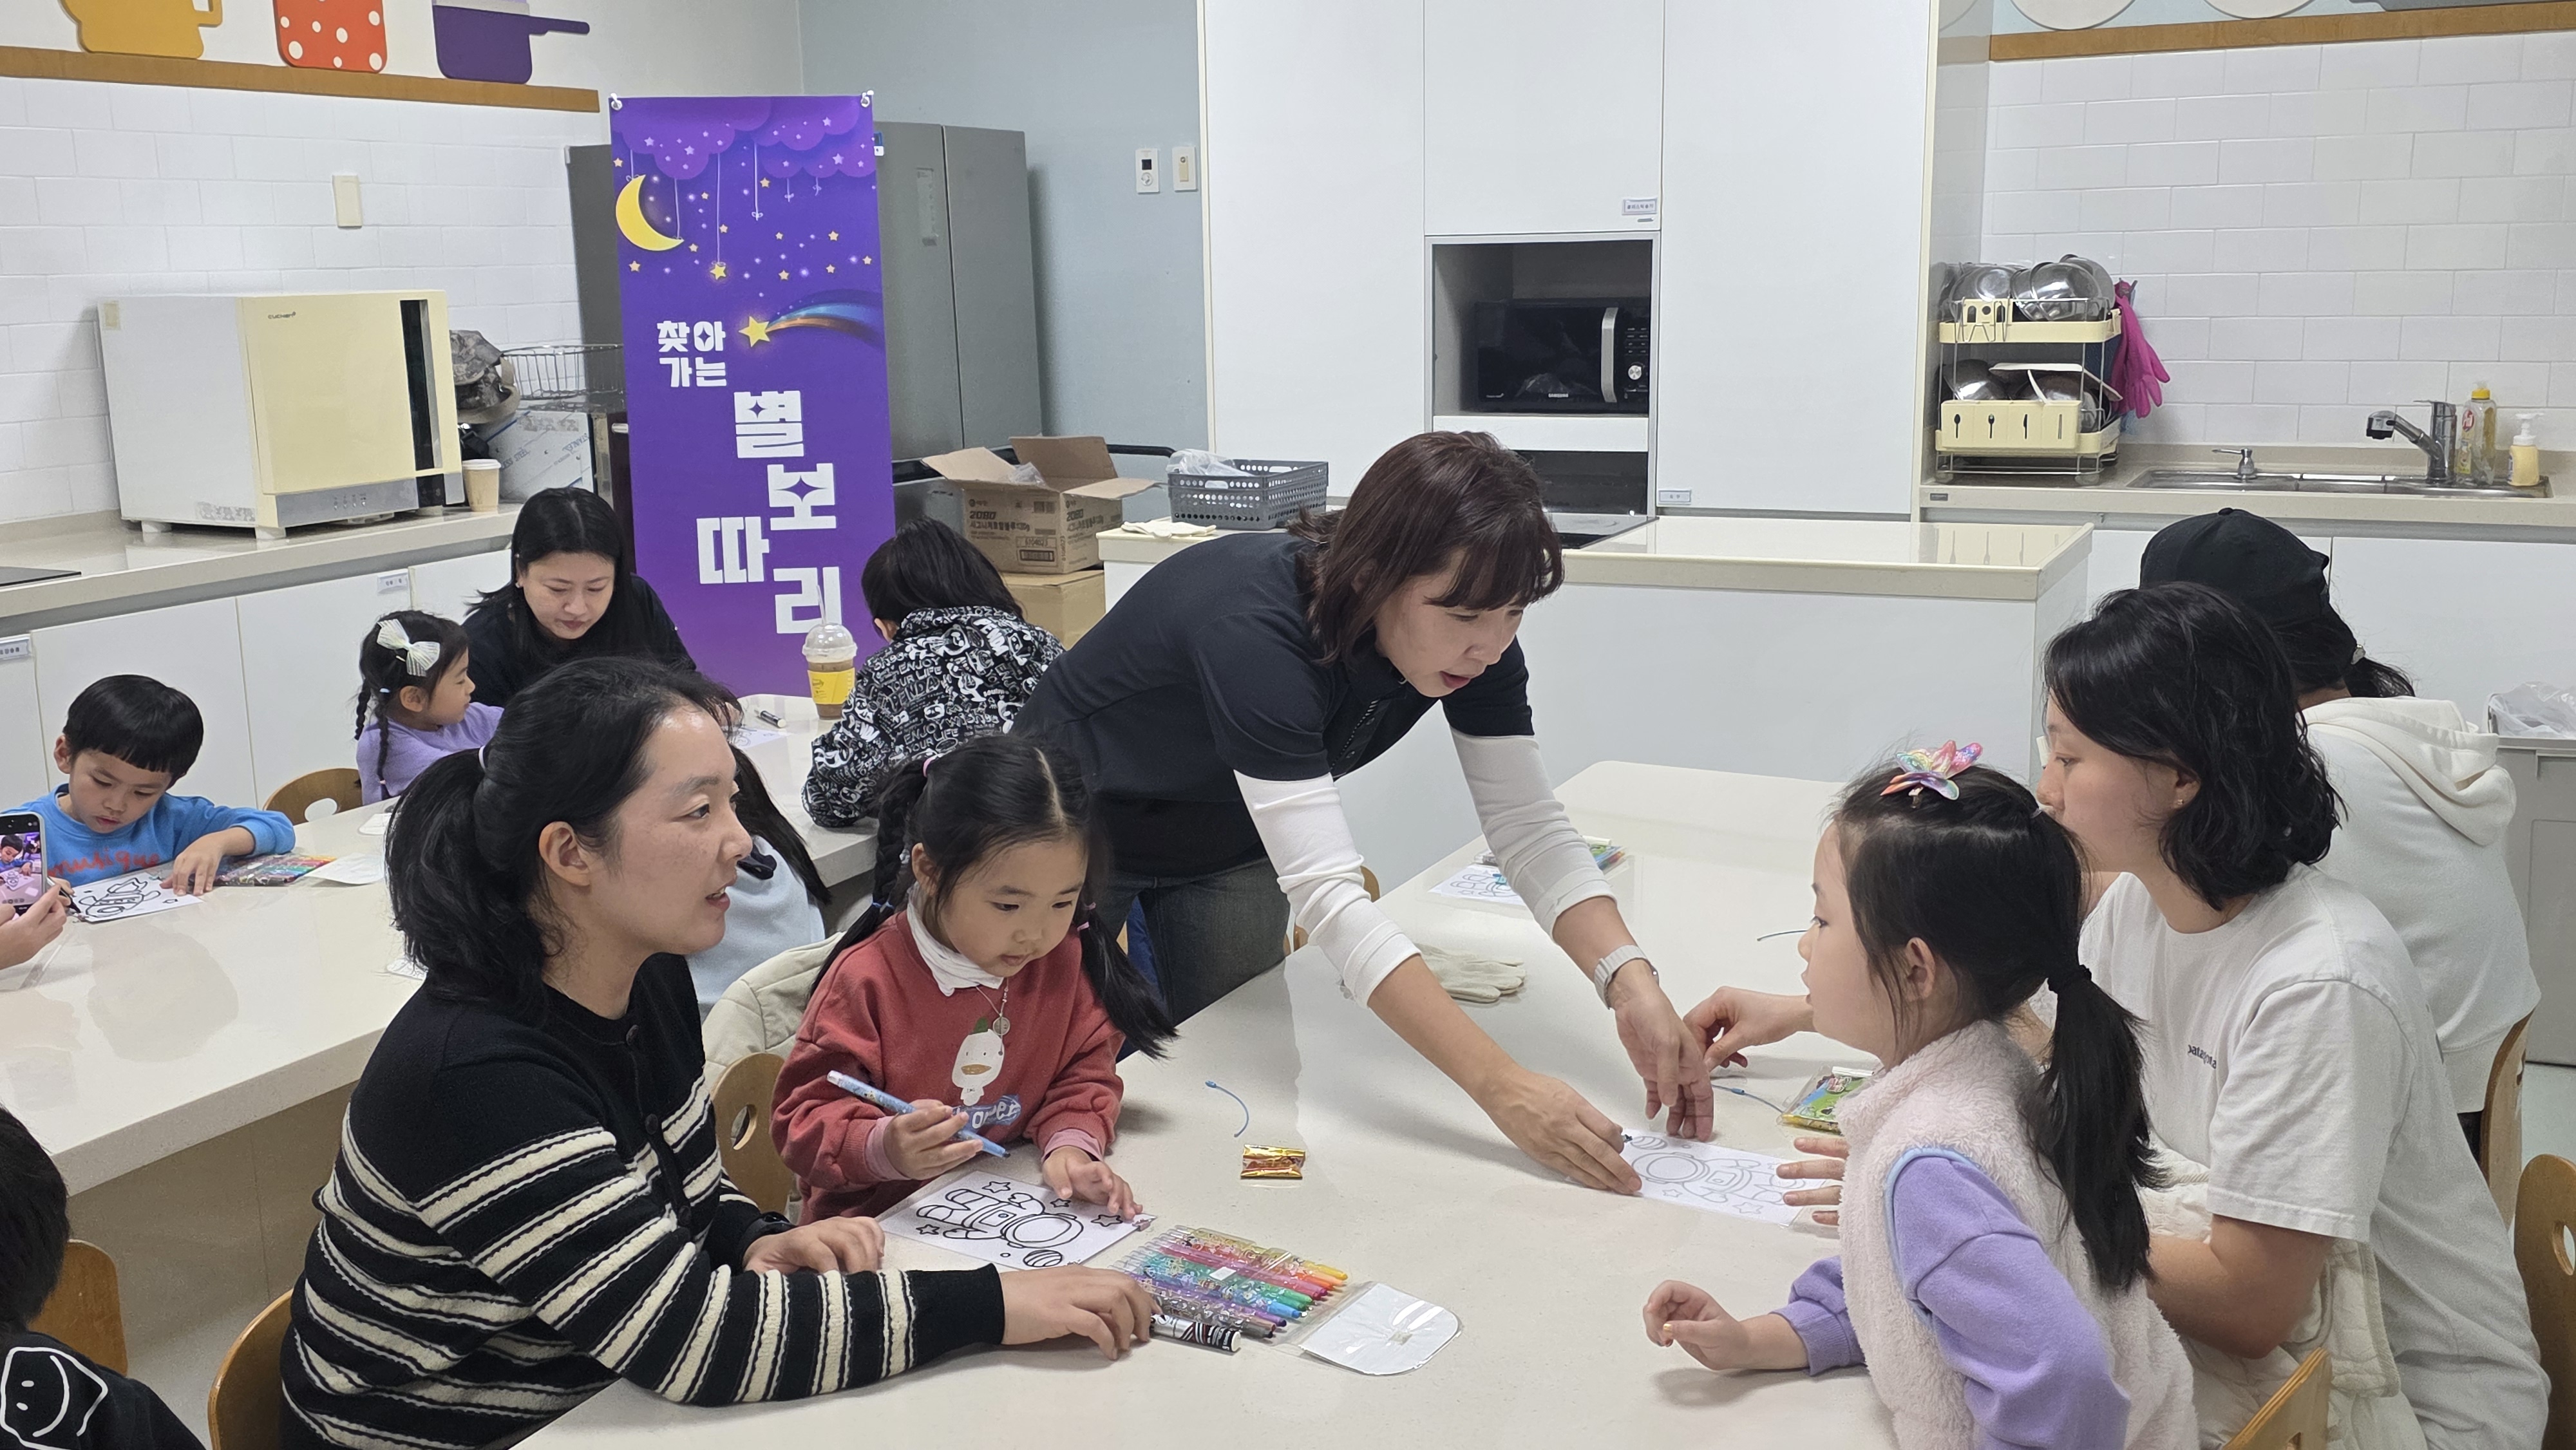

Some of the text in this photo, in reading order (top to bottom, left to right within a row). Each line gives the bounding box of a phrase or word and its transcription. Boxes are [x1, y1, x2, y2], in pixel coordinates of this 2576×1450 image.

[657, 320, 726, 353] 찾아
[659, 357, 727, 388] 가는
[734, 390, 804, 458] 별
[767, 462, 837, 530] 보
[969, 511, 997, 520] 2080
[696, 516, 770, 585] 따
[774, 566, 842, 634] 리
[887, 666, 942, 693] YOUR LIFE
[898, 657, 940, 675] ENJOY
[904, 719, 945, 745] ENJOY
[934, 728, 958, 741] LIFE
